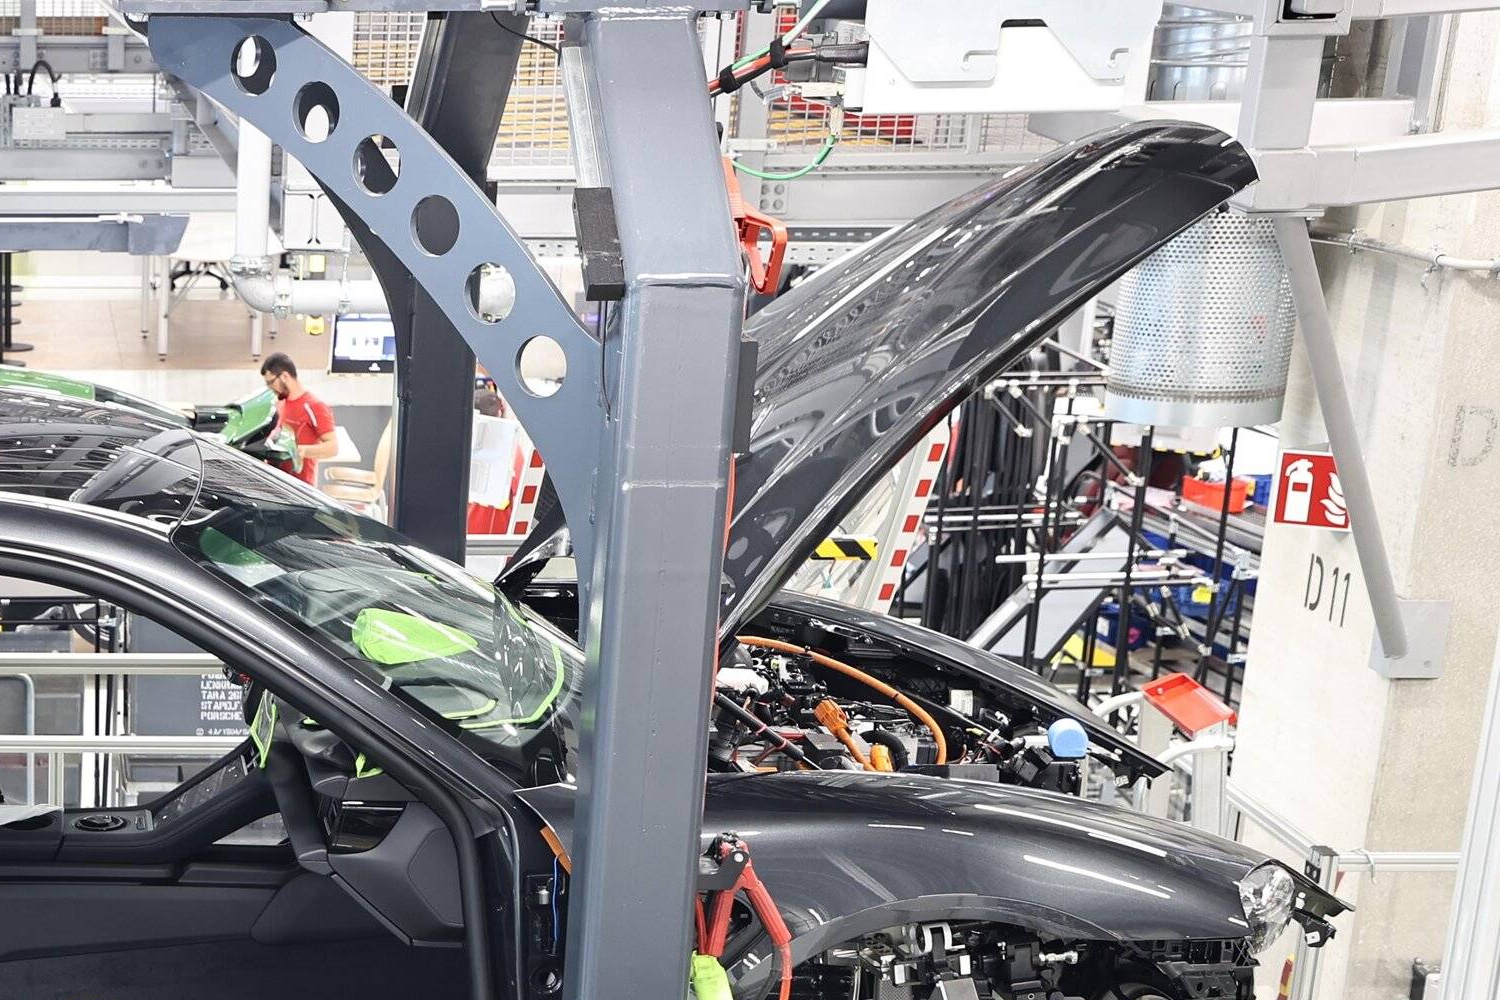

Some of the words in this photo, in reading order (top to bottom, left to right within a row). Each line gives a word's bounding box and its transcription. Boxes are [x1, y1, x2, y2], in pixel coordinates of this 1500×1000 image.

[201, 691, 226, 700] TARA
[200, 701, 242, 711] STAPELF
[200, 711, 242, 721] PORSCHE
